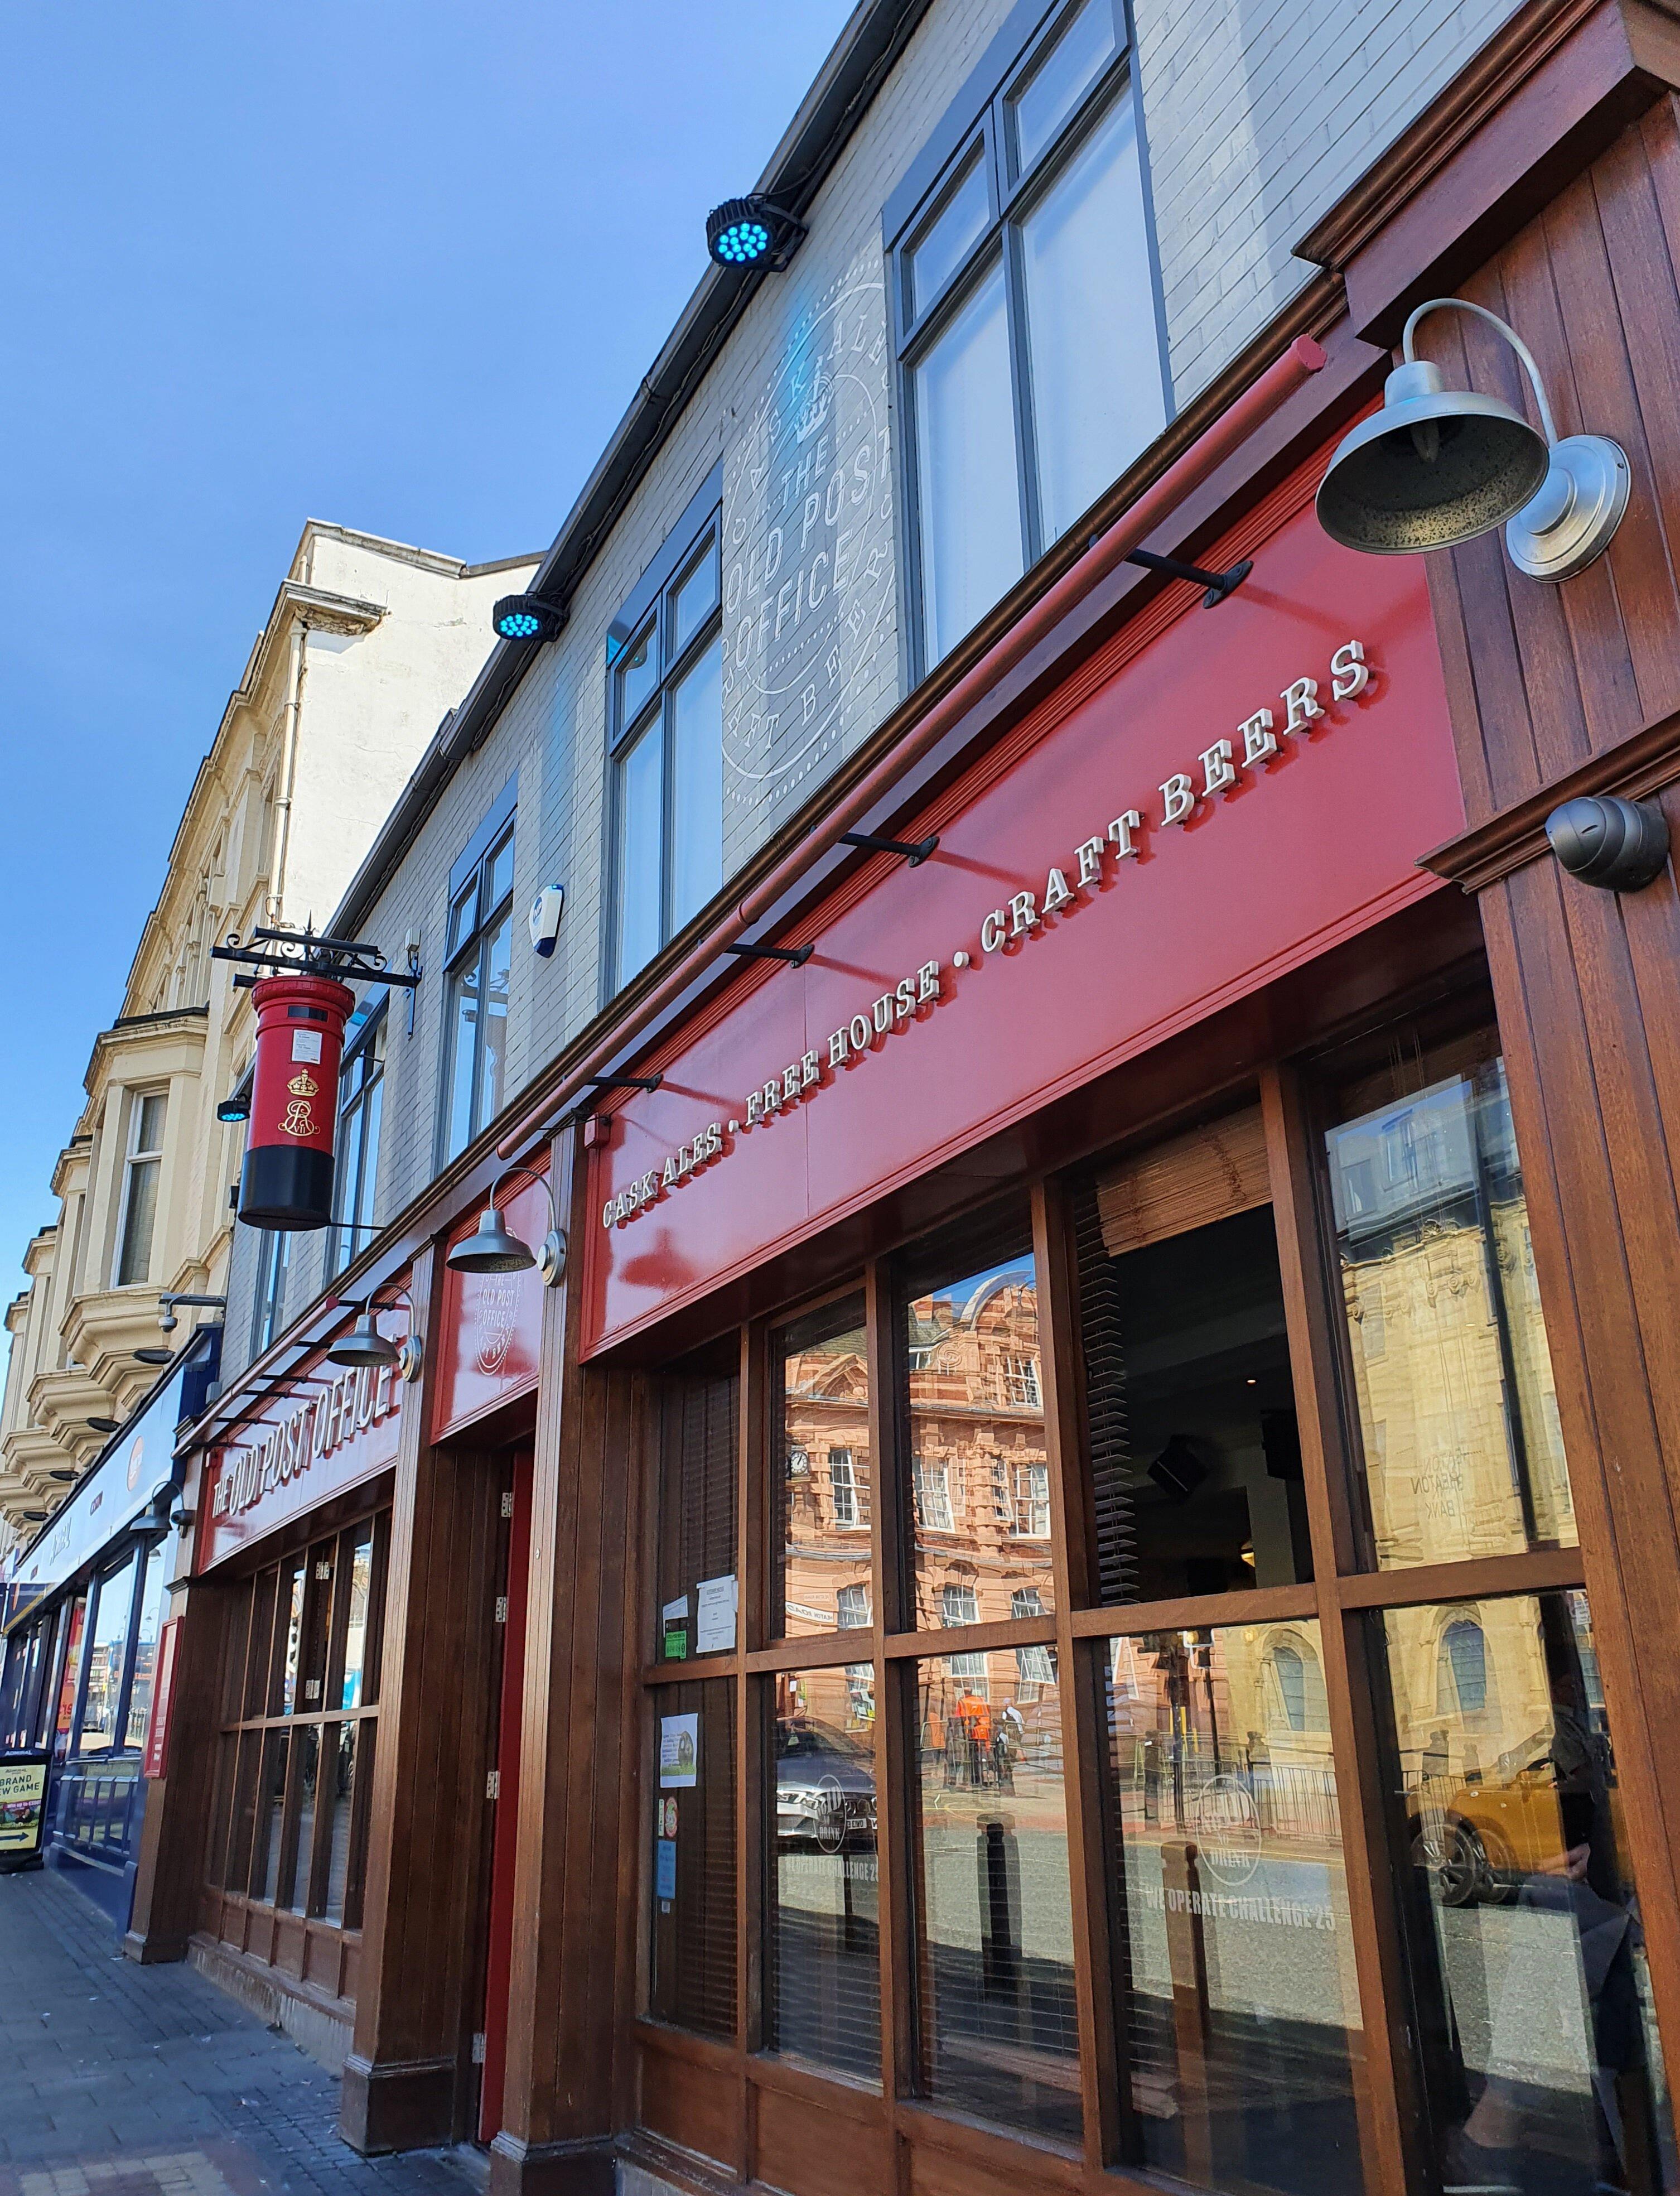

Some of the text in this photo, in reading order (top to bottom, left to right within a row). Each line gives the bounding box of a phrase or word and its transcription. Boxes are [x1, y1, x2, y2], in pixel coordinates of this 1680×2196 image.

[781, 434, 829, 512] THE
[726, 425, 890, 617] OLD POST
[735, 529, 853, 671] OFFICE
[603, 640, 1369, 1229] CASK ALES FREE HOUSE CRAFT BEERS
[495, 1273, 505, 1287] THE
[482, 1288, 515, 1307] OLD POST
[482, 1309, 506, 1329] OFFICE
[212, 1473, 234, 1519] THE
[229, 1443, 261, 1516] OLD
[259, 1399, 313, 1495] POST
[0, 1774, 32, 1786] BRAND
[13, 1781, 40, 1793] GAME
[819, 1826, 840, 1841] DRINK
[1167, 1888, 1227, 1918] OPERATE
[1229, 1895, 1312, 1928] CHALLENGE
